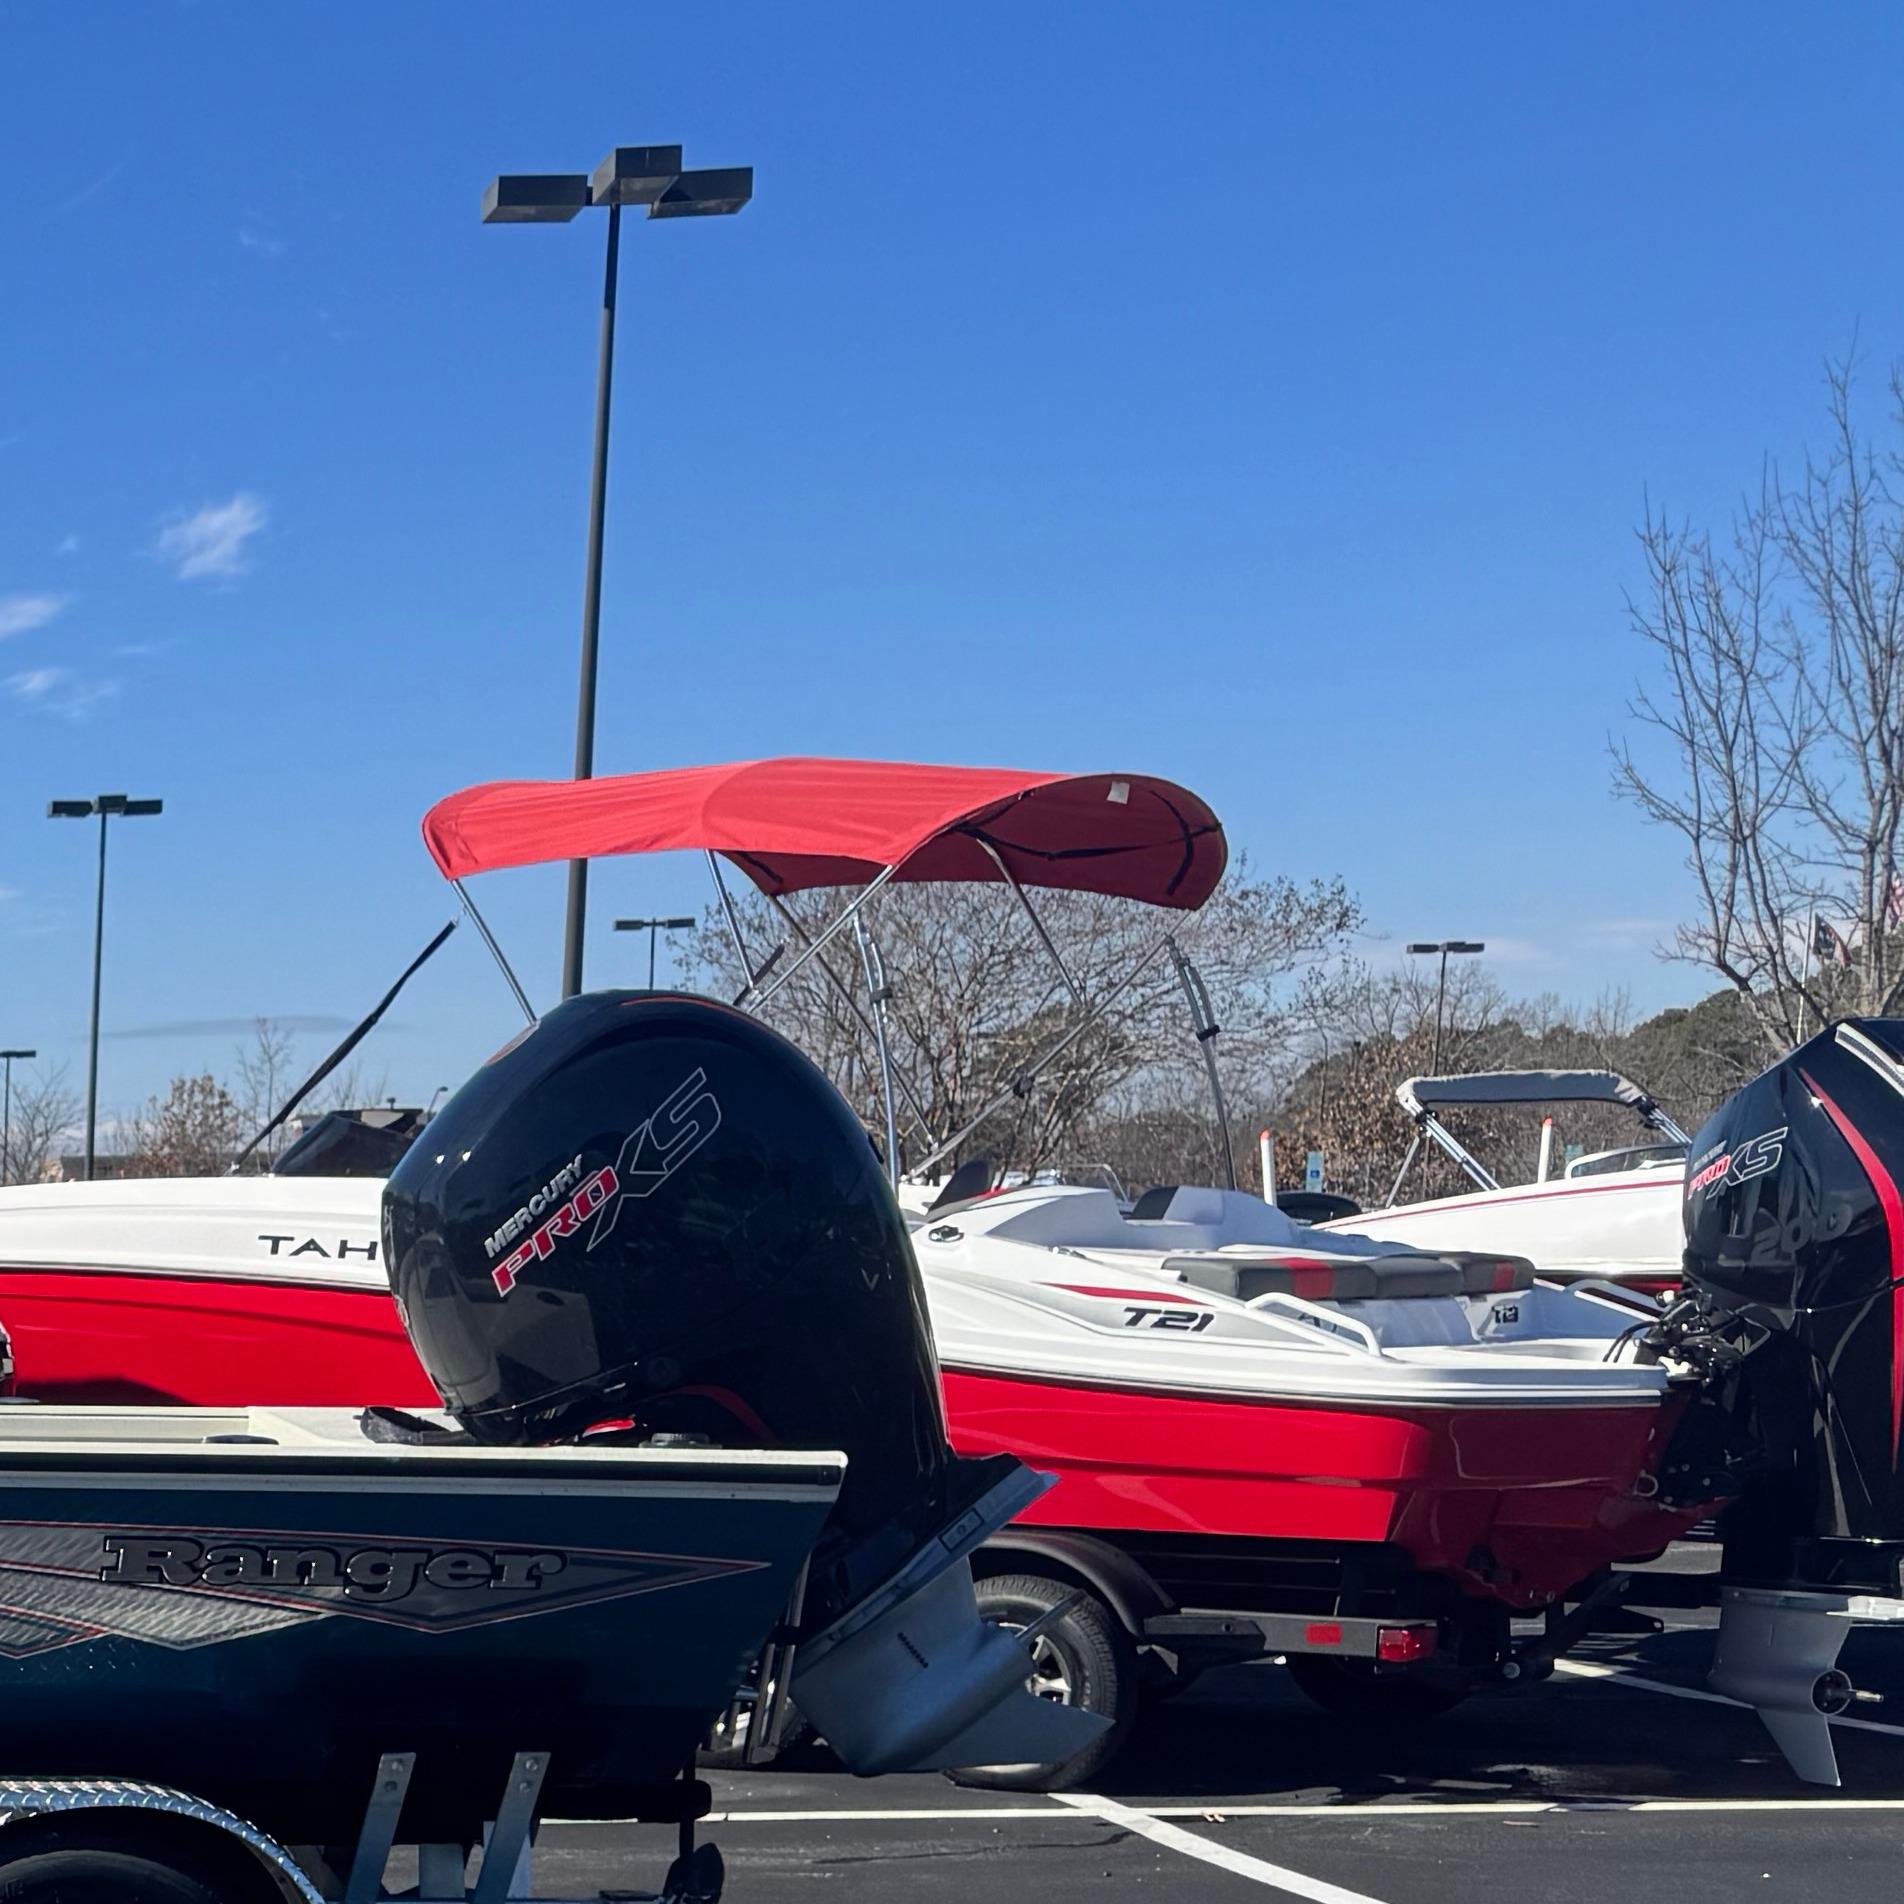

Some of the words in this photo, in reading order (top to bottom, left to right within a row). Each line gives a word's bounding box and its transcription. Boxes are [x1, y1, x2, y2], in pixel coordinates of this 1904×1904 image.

[484, 1153, 583, 1258] MERCURY
[492, 1165, 620, 1297] PRO
[586, 1066, 722, 1252] XS
[257, 1234, 378, 1261] TAH
[1123, 1306, 1214, 1332] T21
[101, 1535, 568, 1600] Ranger
